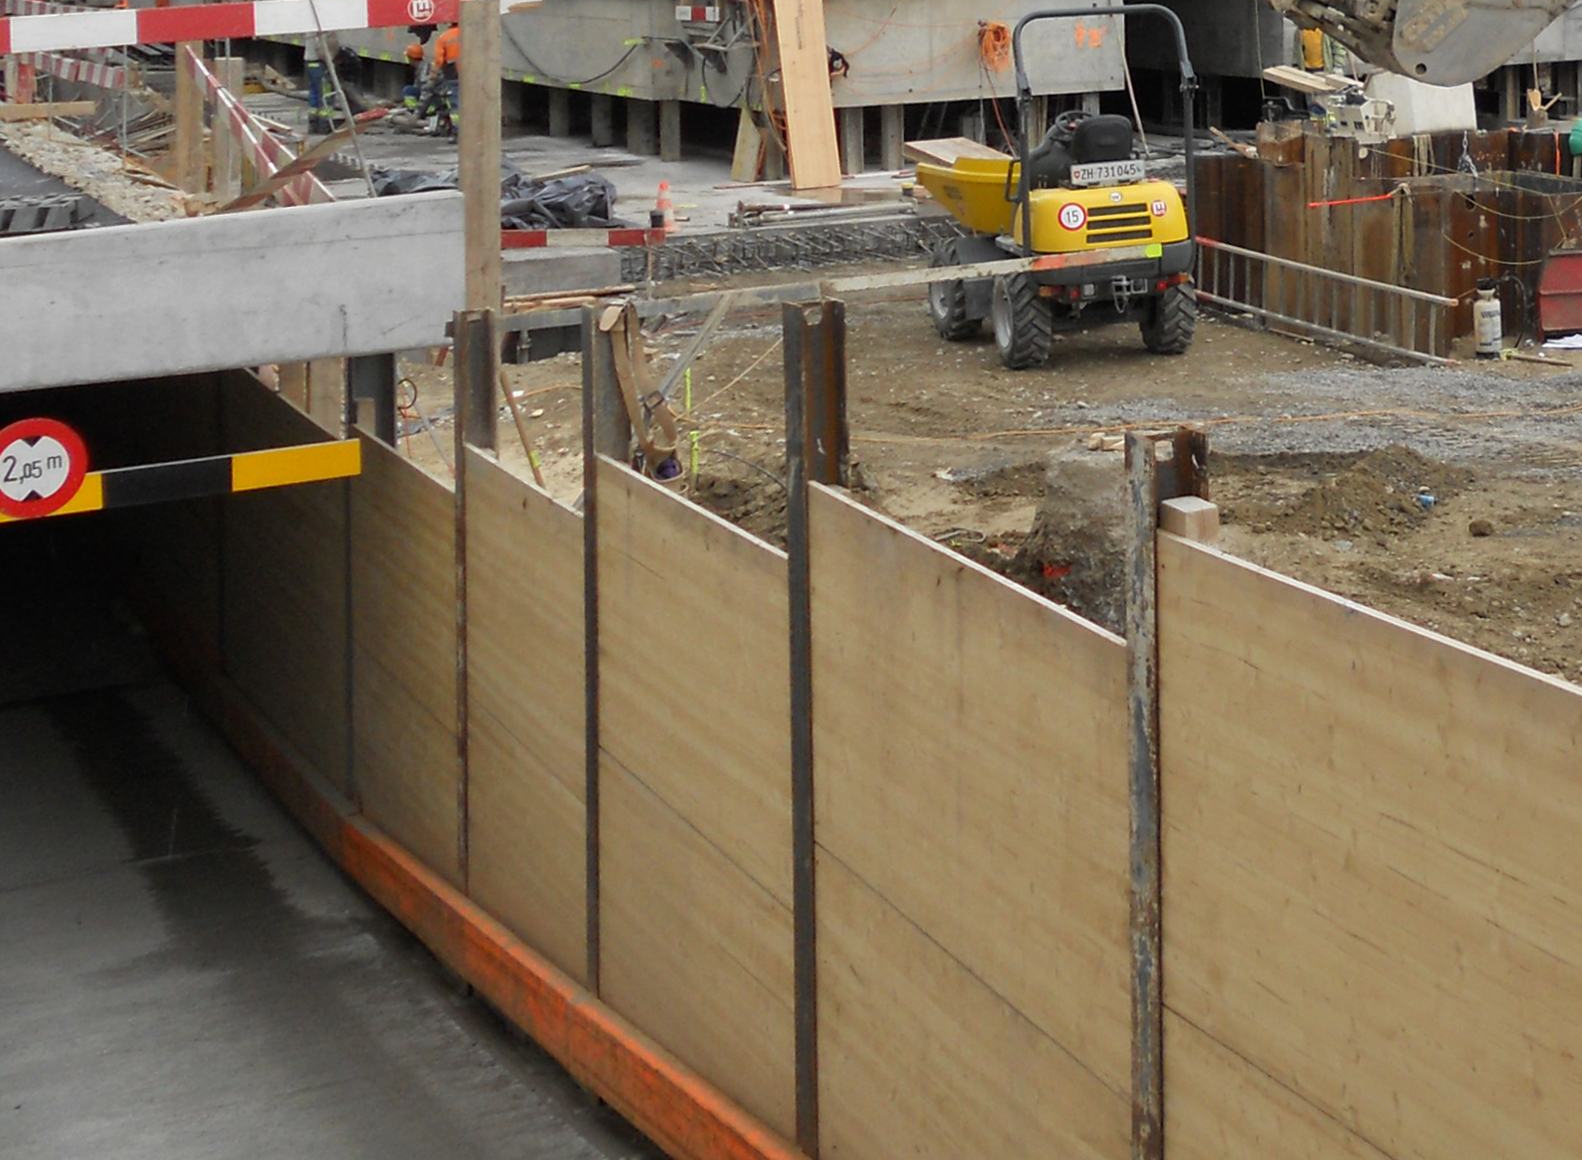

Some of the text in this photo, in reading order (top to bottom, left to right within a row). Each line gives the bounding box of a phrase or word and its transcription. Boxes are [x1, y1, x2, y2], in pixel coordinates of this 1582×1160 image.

[1081, 168, 1094, 180] ZH
[1066, 210, 1079, 223] 15
[3, 455, 62, 485] 2,05 m
